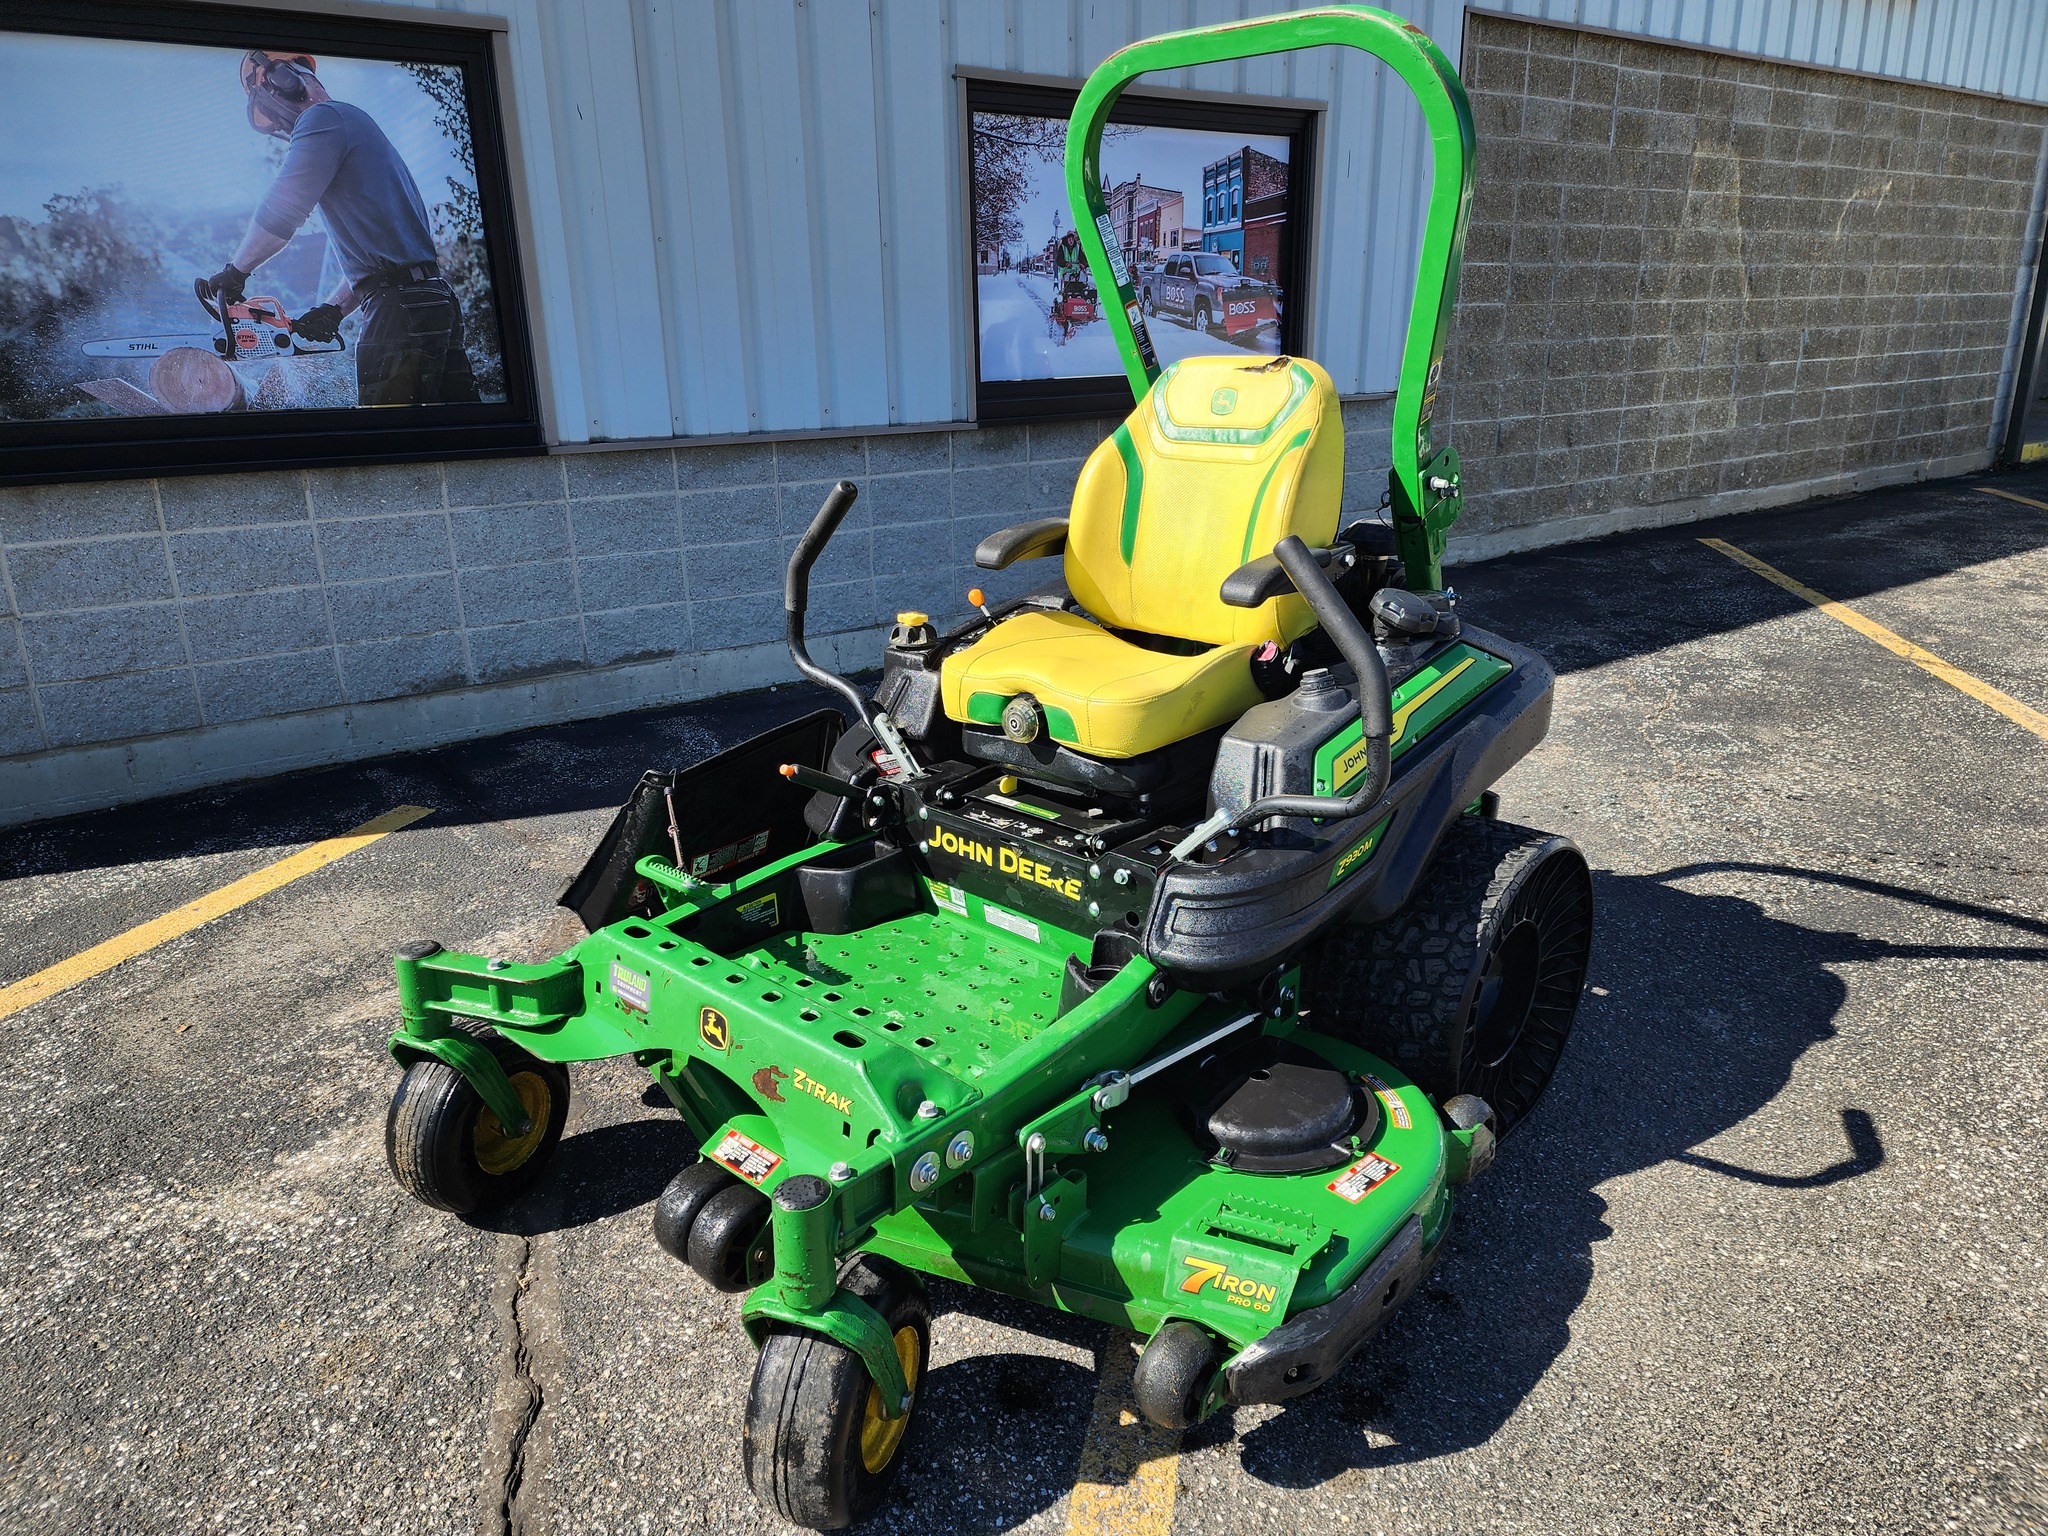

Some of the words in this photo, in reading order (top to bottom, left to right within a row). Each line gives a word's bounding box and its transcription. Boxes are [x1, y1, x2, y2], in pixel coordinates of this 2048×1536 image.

[1165, 285, 1185, 303] BOSS
[1228, 300, 1256, 316] BOSS
[128, 342, 158, 351] STIHL
[1343, 746, 1367, 773] JOHN
[928, 825, 993, 867] JOHN
[999, 846, 1082, 901] DEERE
[1336, 837, 1374, 877] Z930M
[613, 963, 647, 992] TRULAND
[793, 1067, 853, 1117] ZTRAK
[1226, 1294, 1251, 1307] PRO
[1253, 1302, 1271, 1313] 60
